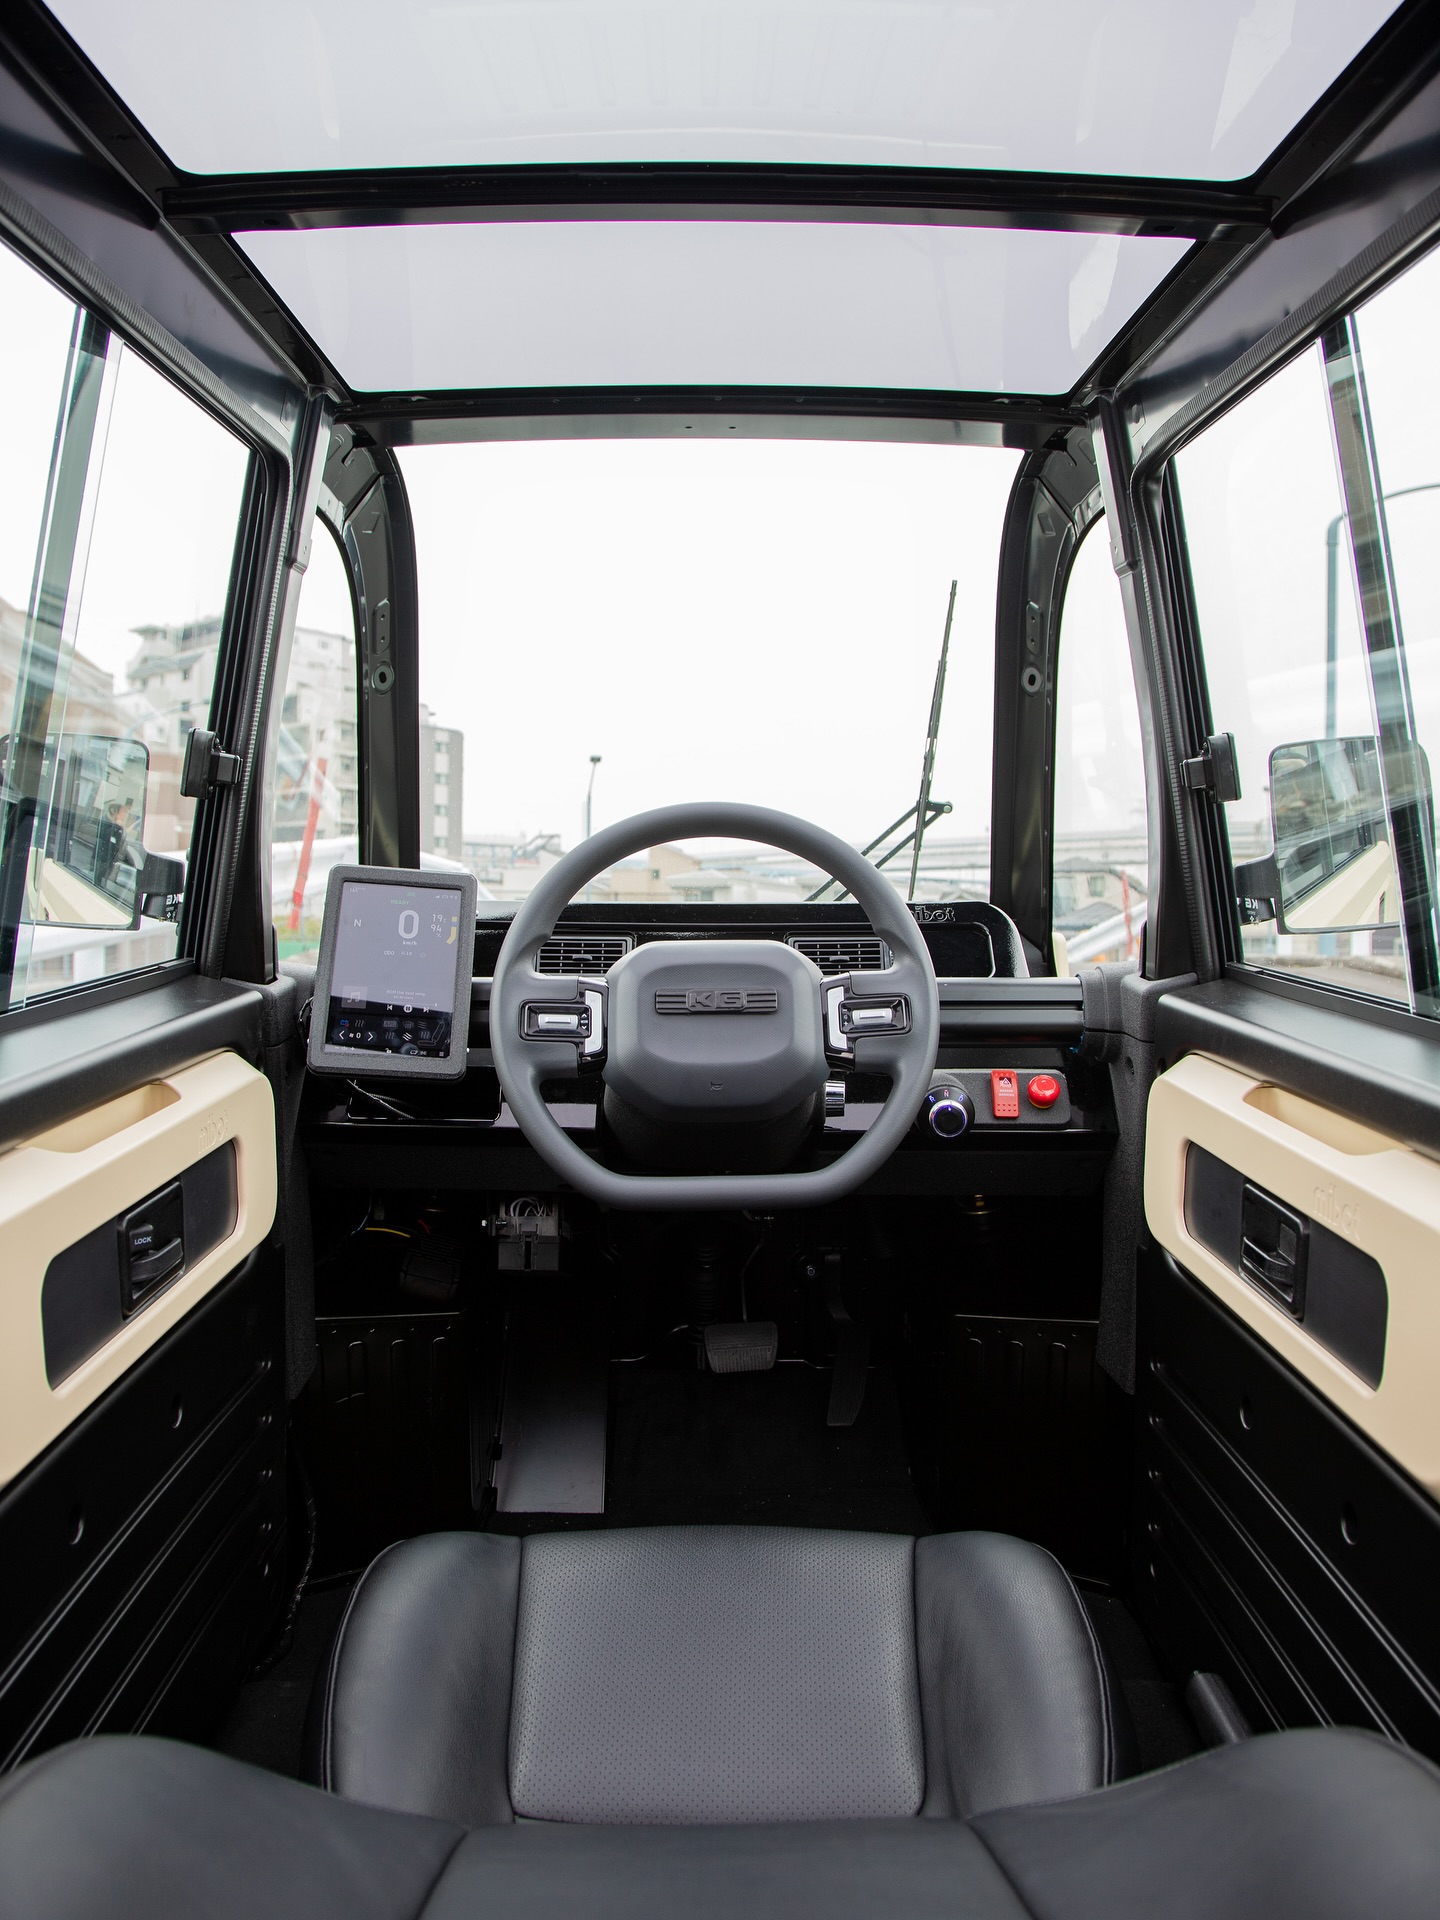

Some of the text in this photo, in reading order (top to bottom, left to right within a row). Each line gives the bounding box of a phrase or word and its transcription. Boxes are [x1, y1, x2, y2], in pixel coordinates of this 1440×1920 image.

[353, 918, 362, 928] N
[398, 909, 420, 939] 0
[689, 992, 744, 1009] KG
[134, 1236, 152, 1245] LOCK
